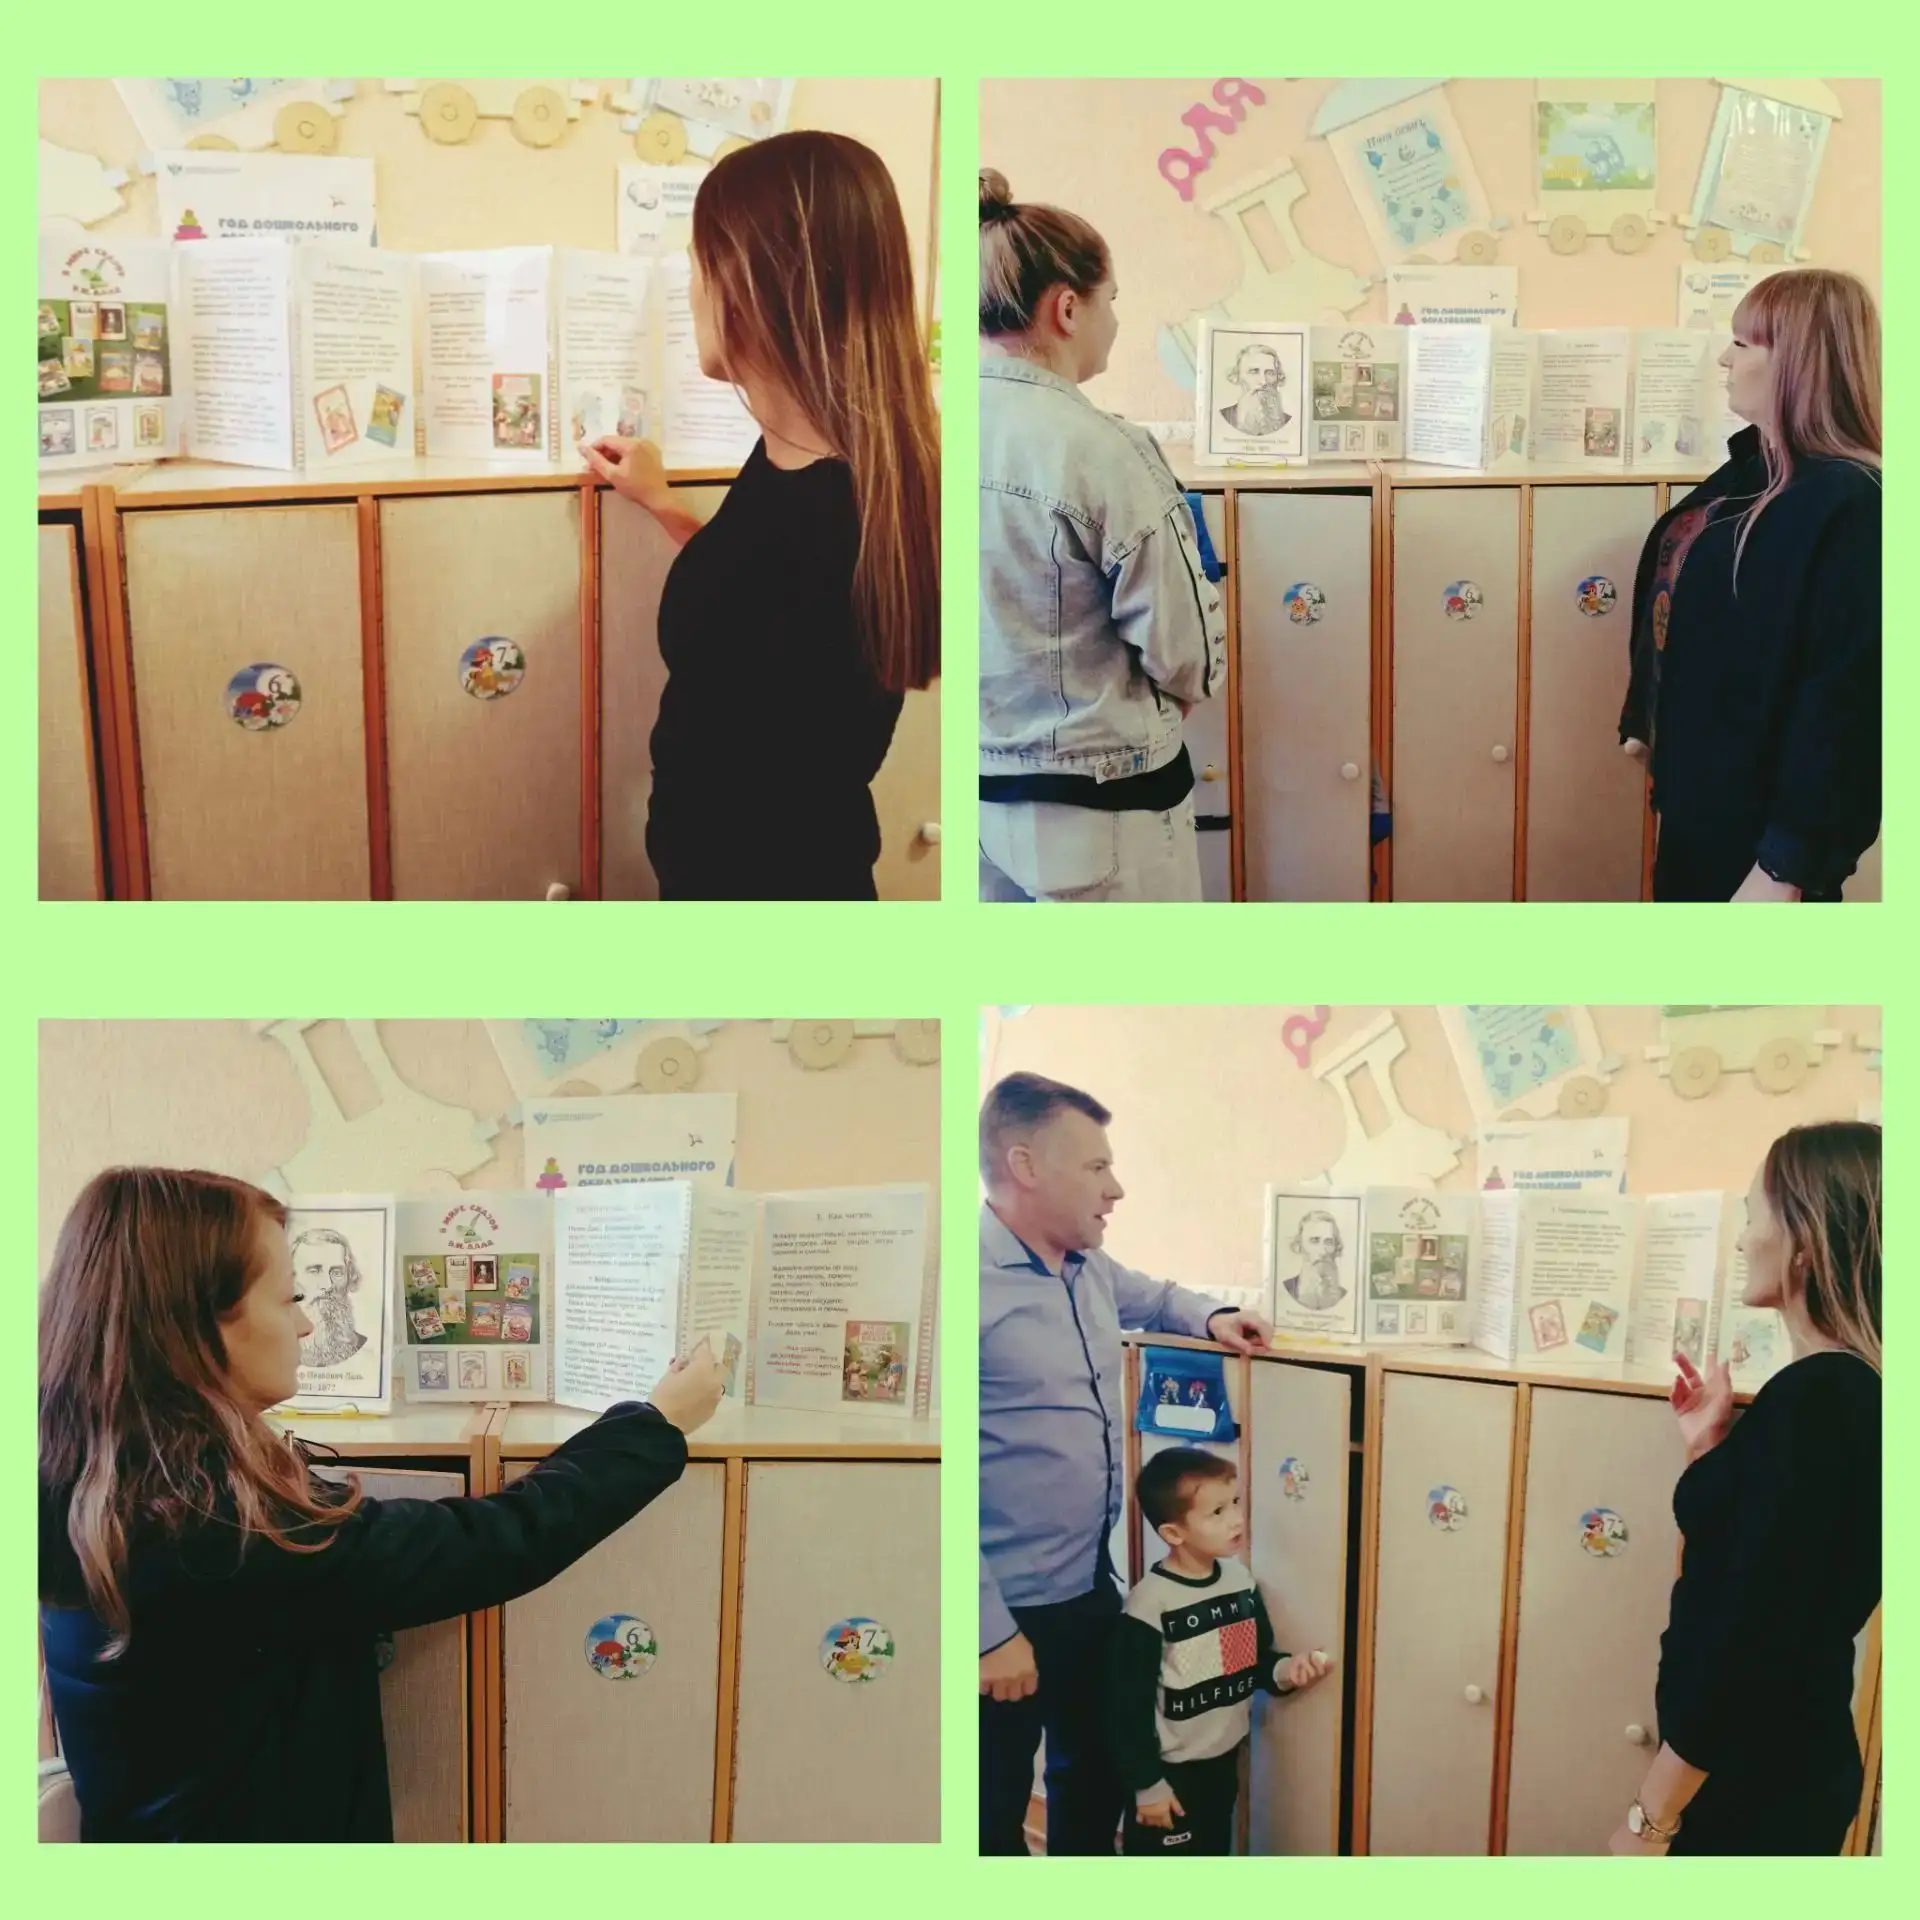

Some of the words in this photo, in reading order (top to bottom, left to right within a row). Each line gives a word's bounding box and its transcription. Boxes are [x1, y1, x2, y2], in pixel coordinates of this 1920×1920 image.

[218, 217, 249, 230] ГОД
[252, 219, 360, 232] ДОШКОЛЬНОГО
[1304, 587, 1314, 601] 5
[1464, 586, 1474, 600] 6
[1599, 582, 1607, 596] 7
[496, 645, 508, 665] 7
[267, 674, 282, 695] 6
[577, 1163, 607, 1176] ГОД
[609, 1160, 717, 1175] ДОШКОЛЬНОГО
[625, 1626, 640, 1647] 6
[863, 1629, 878, 1648] 7
[1171, 1675, 1254, 1714] HILFIGE
